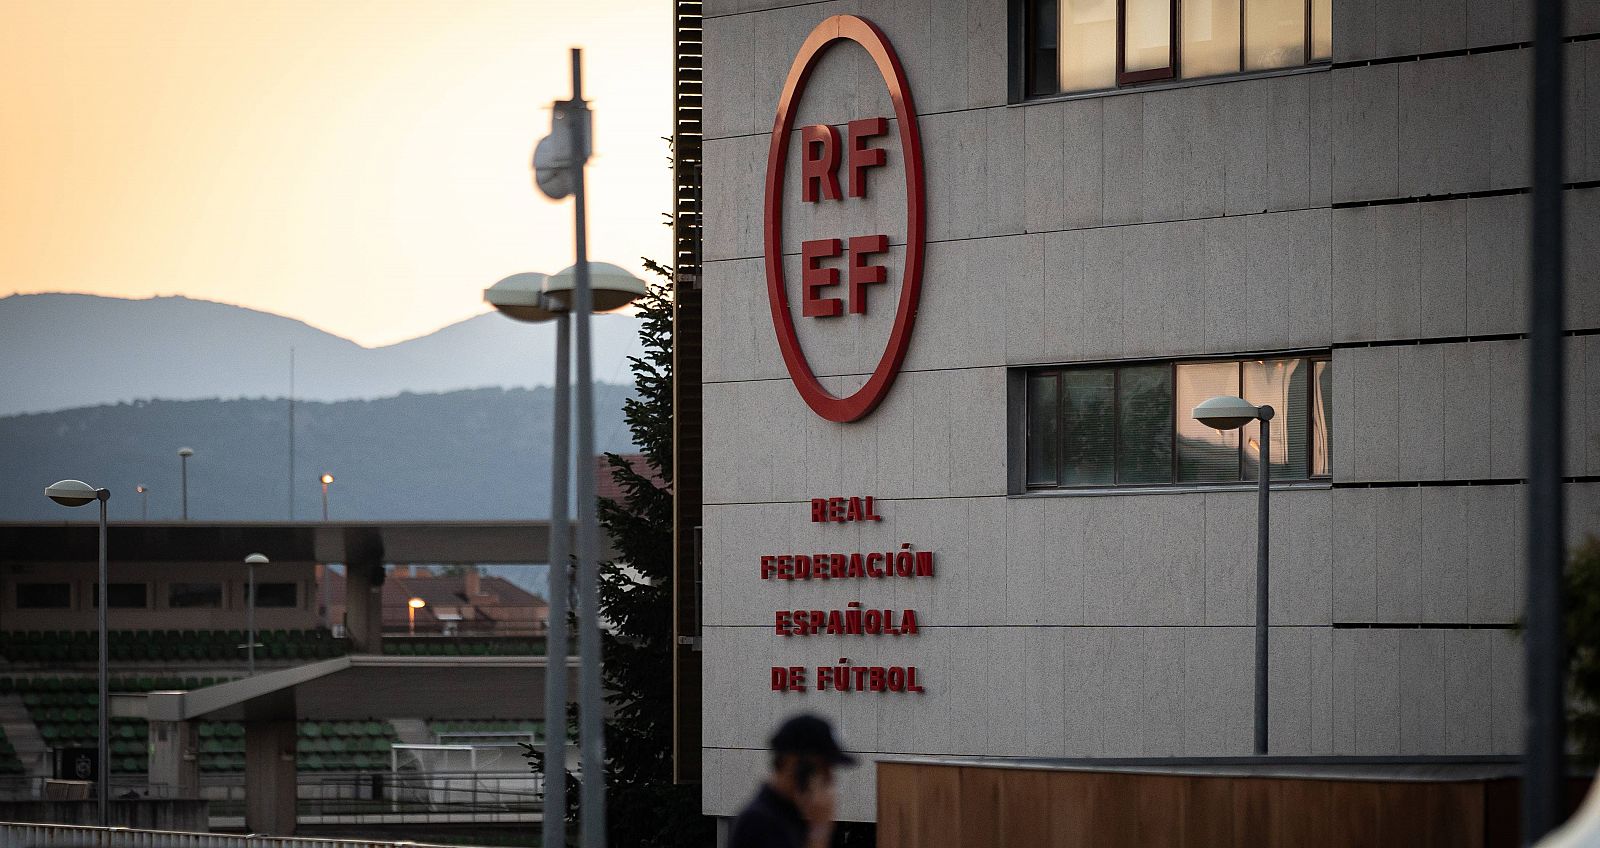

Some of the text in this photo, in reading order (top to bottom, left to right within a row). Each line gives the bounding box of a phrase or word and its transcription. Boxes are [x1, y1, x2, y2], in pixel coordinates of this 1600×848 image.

[801, 116, 889, 204] RF
[801, 233, 890, 319] EF
[811, 496, 882, 523] REAL
[760, 542, 934, 580] FEDERACIÓN
[775, 601, 919, 636] ESPAÑOLA
[771, 657, 924, 692] DE FÚTBOL
